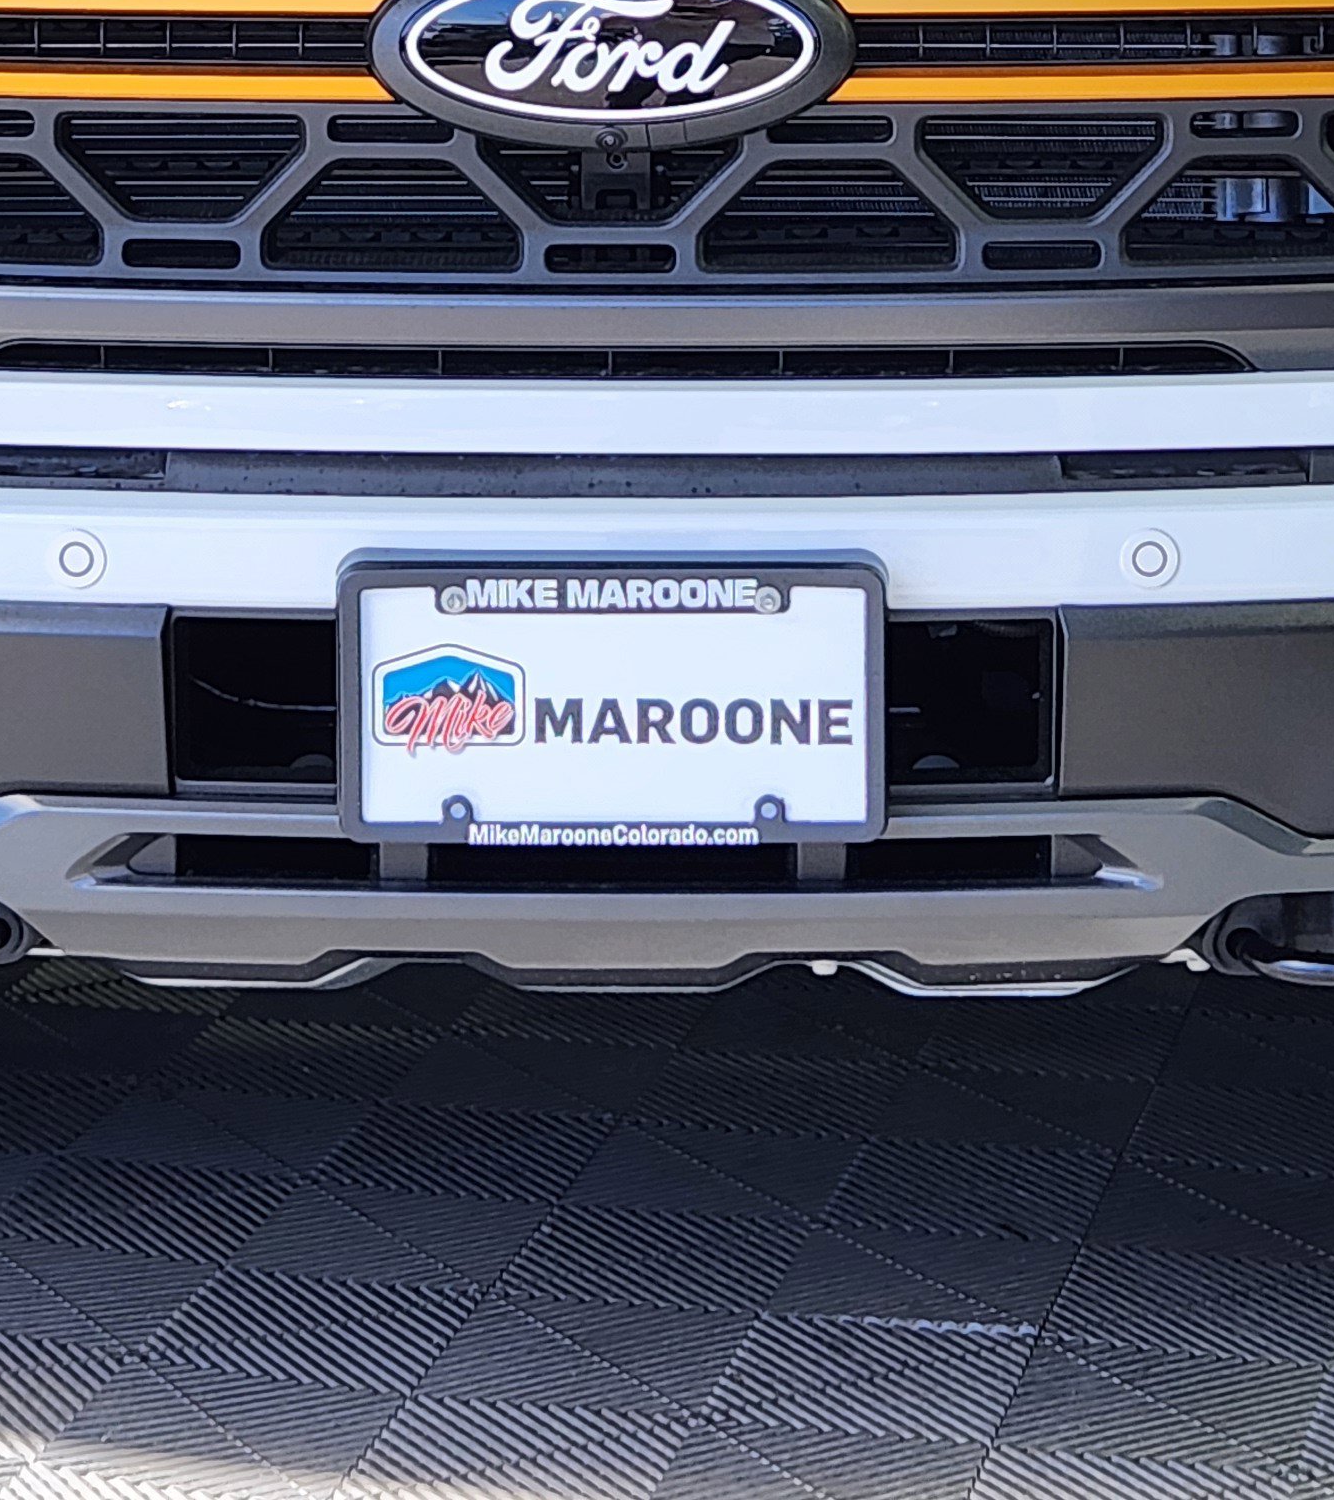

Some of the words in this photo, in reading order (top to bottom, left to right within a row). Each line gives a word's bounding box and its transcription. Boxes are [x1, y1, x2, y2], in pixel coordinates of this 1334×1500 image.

[466, 578, 558, 608] MIKE
[567, 578, 757, 608] MAROONE
[385, 689, 515, 752] Mike
[534, 697, 853, 745] MAROONE
[468, 823, 759, 845] MikeMarooneColorado.com
